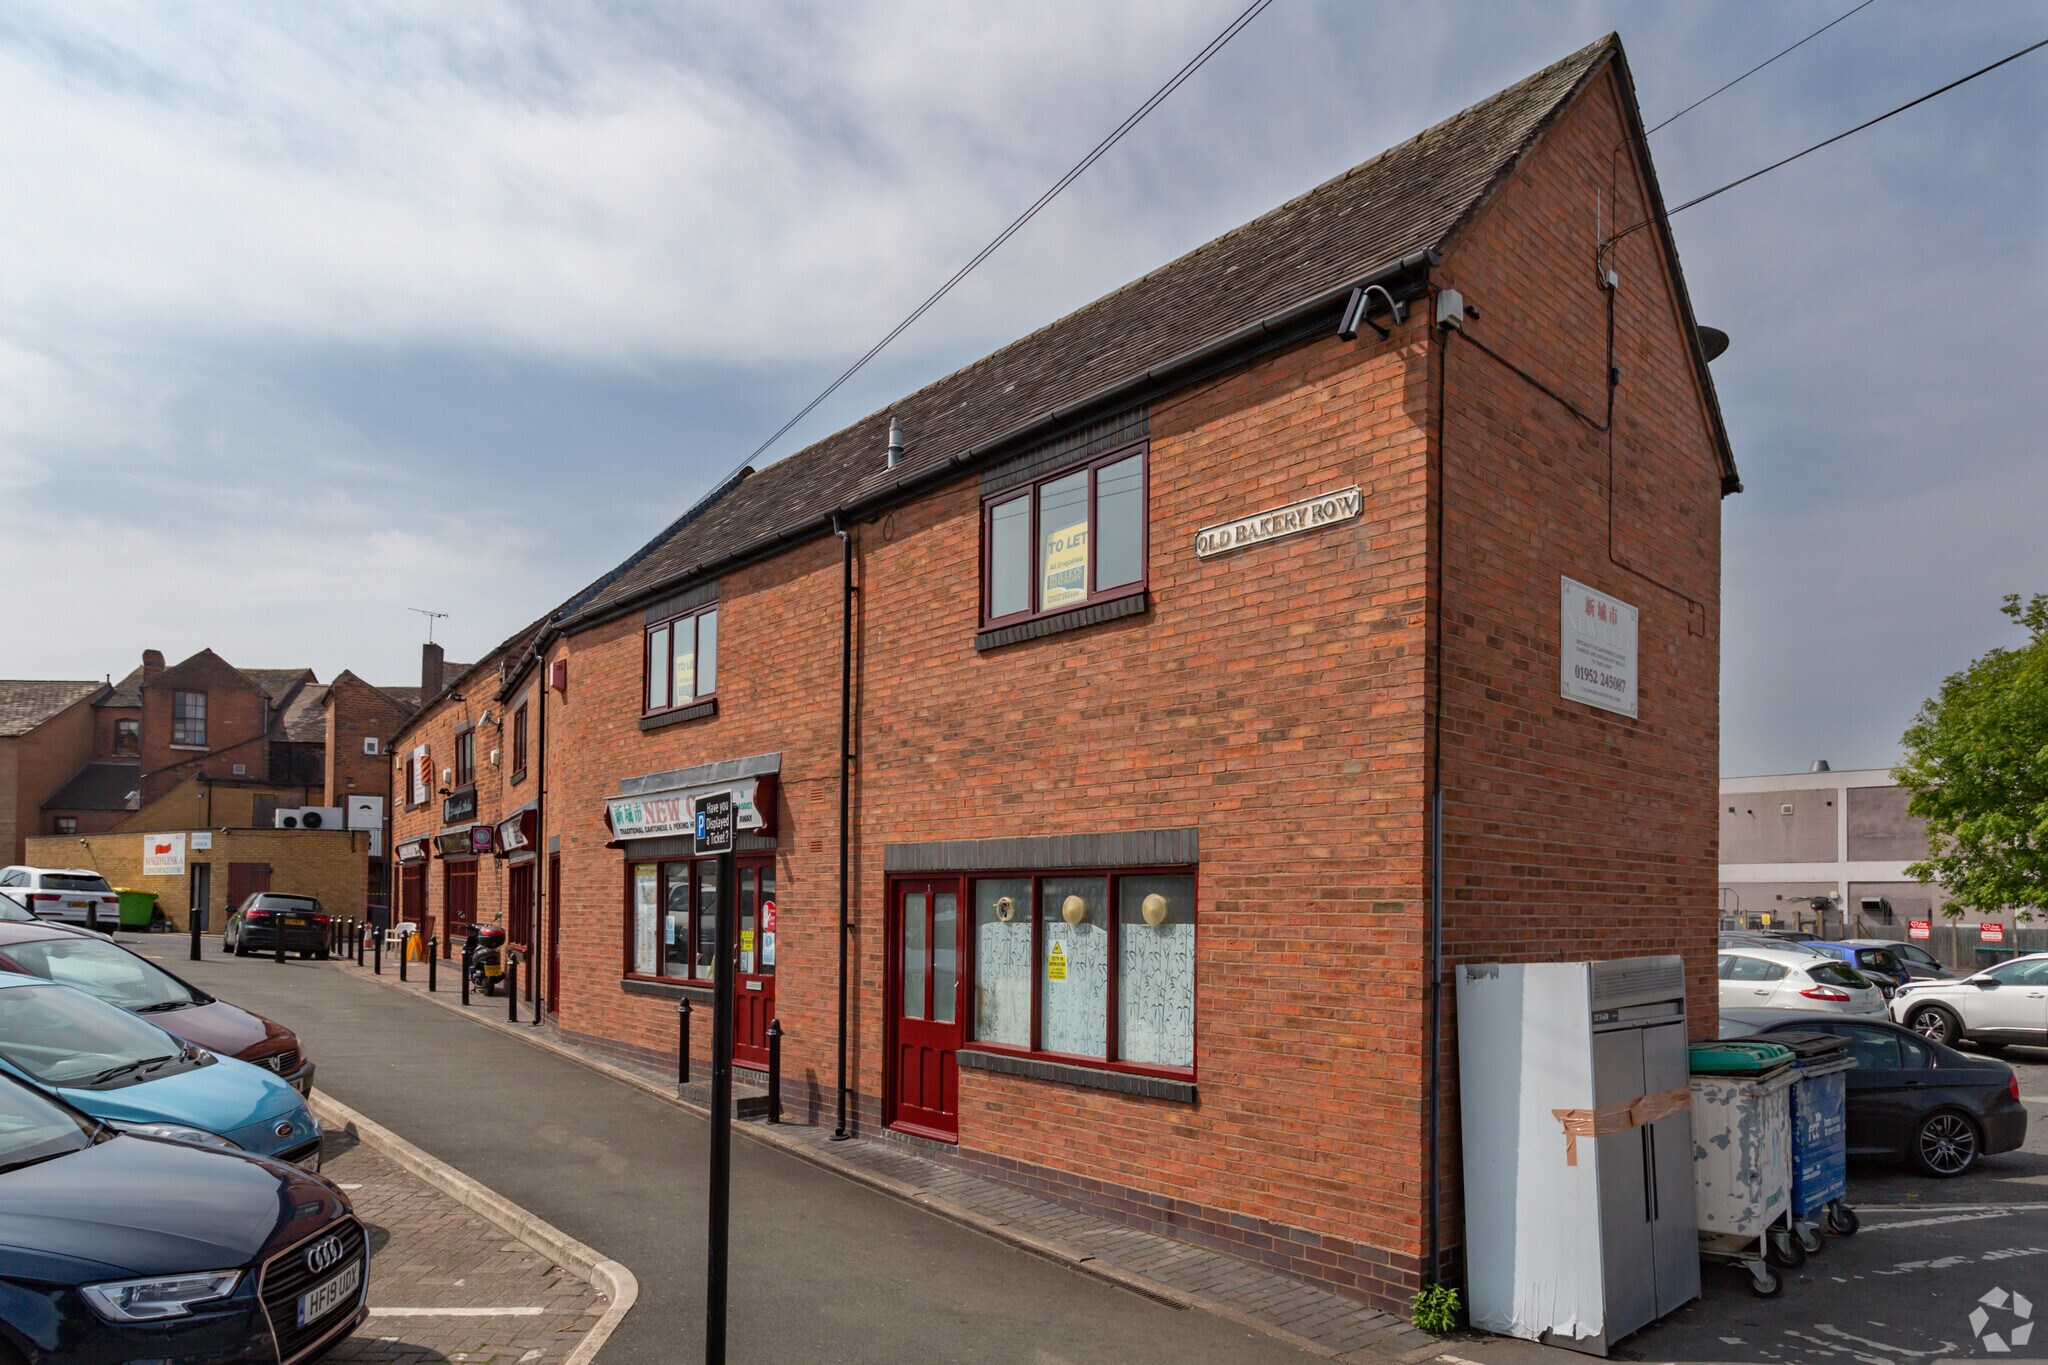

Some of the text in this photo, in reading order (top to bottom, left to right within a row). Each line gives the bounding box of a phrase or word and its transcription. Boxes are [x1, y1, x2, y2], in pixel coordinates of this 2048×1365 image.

[1197, 494, 1358, 553] OLD BAKERY ROW
[1048, 530, 1088, 555] TO LET
[1585, 596, 1618, 626] 新城市
[1603, 626, 1633, 653] CITY
[1575, 664, 1626, 693] 01952 245087
[613, 802, 643, 826] 新城市
[642, 797, 680, 825] NEW
[706, 802, 719, 814] Have
[719, 801, 729, 814] you
[619, 827, 644, 835] TRADITIONAL
[644, 824, 668, 833] CANTONESE
[673, 822, 689, 830] PEKING
[739, 814, 752, 823] AWAY
[698, 814, 704, 837] P
[706, 814, 729, 830] Displayed
[706, 836, 710, 845] a
[145, 856, 183, 866] MAGDALENKA
[310, 1264, 358, 1316] HF19 UDX
